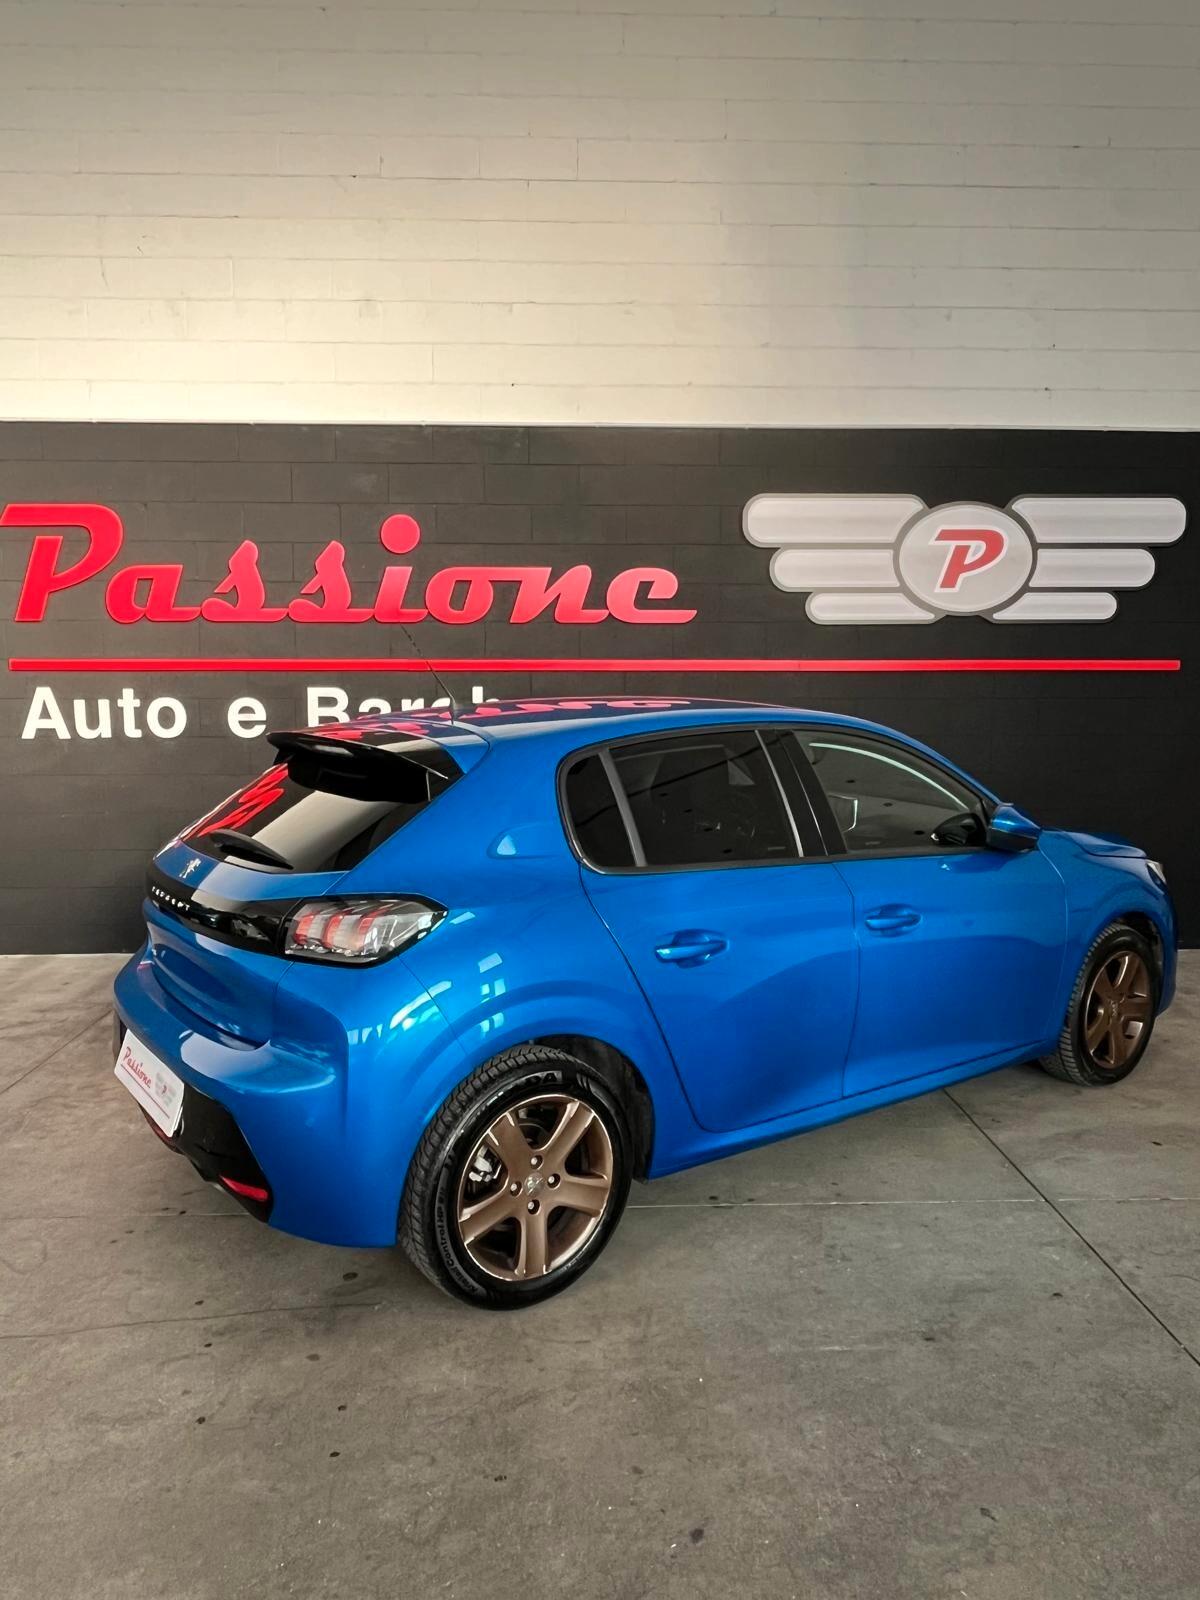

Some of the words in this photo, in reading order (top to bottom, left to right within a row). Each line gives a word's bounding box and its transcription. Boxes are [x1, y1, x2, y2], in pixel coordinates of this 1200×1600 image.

[0, 503, 697, 624] Passione
[930, 526, 1007, 592] P
[21, 686, 187, 739] Auto
[227, 697, 267, 738] e
